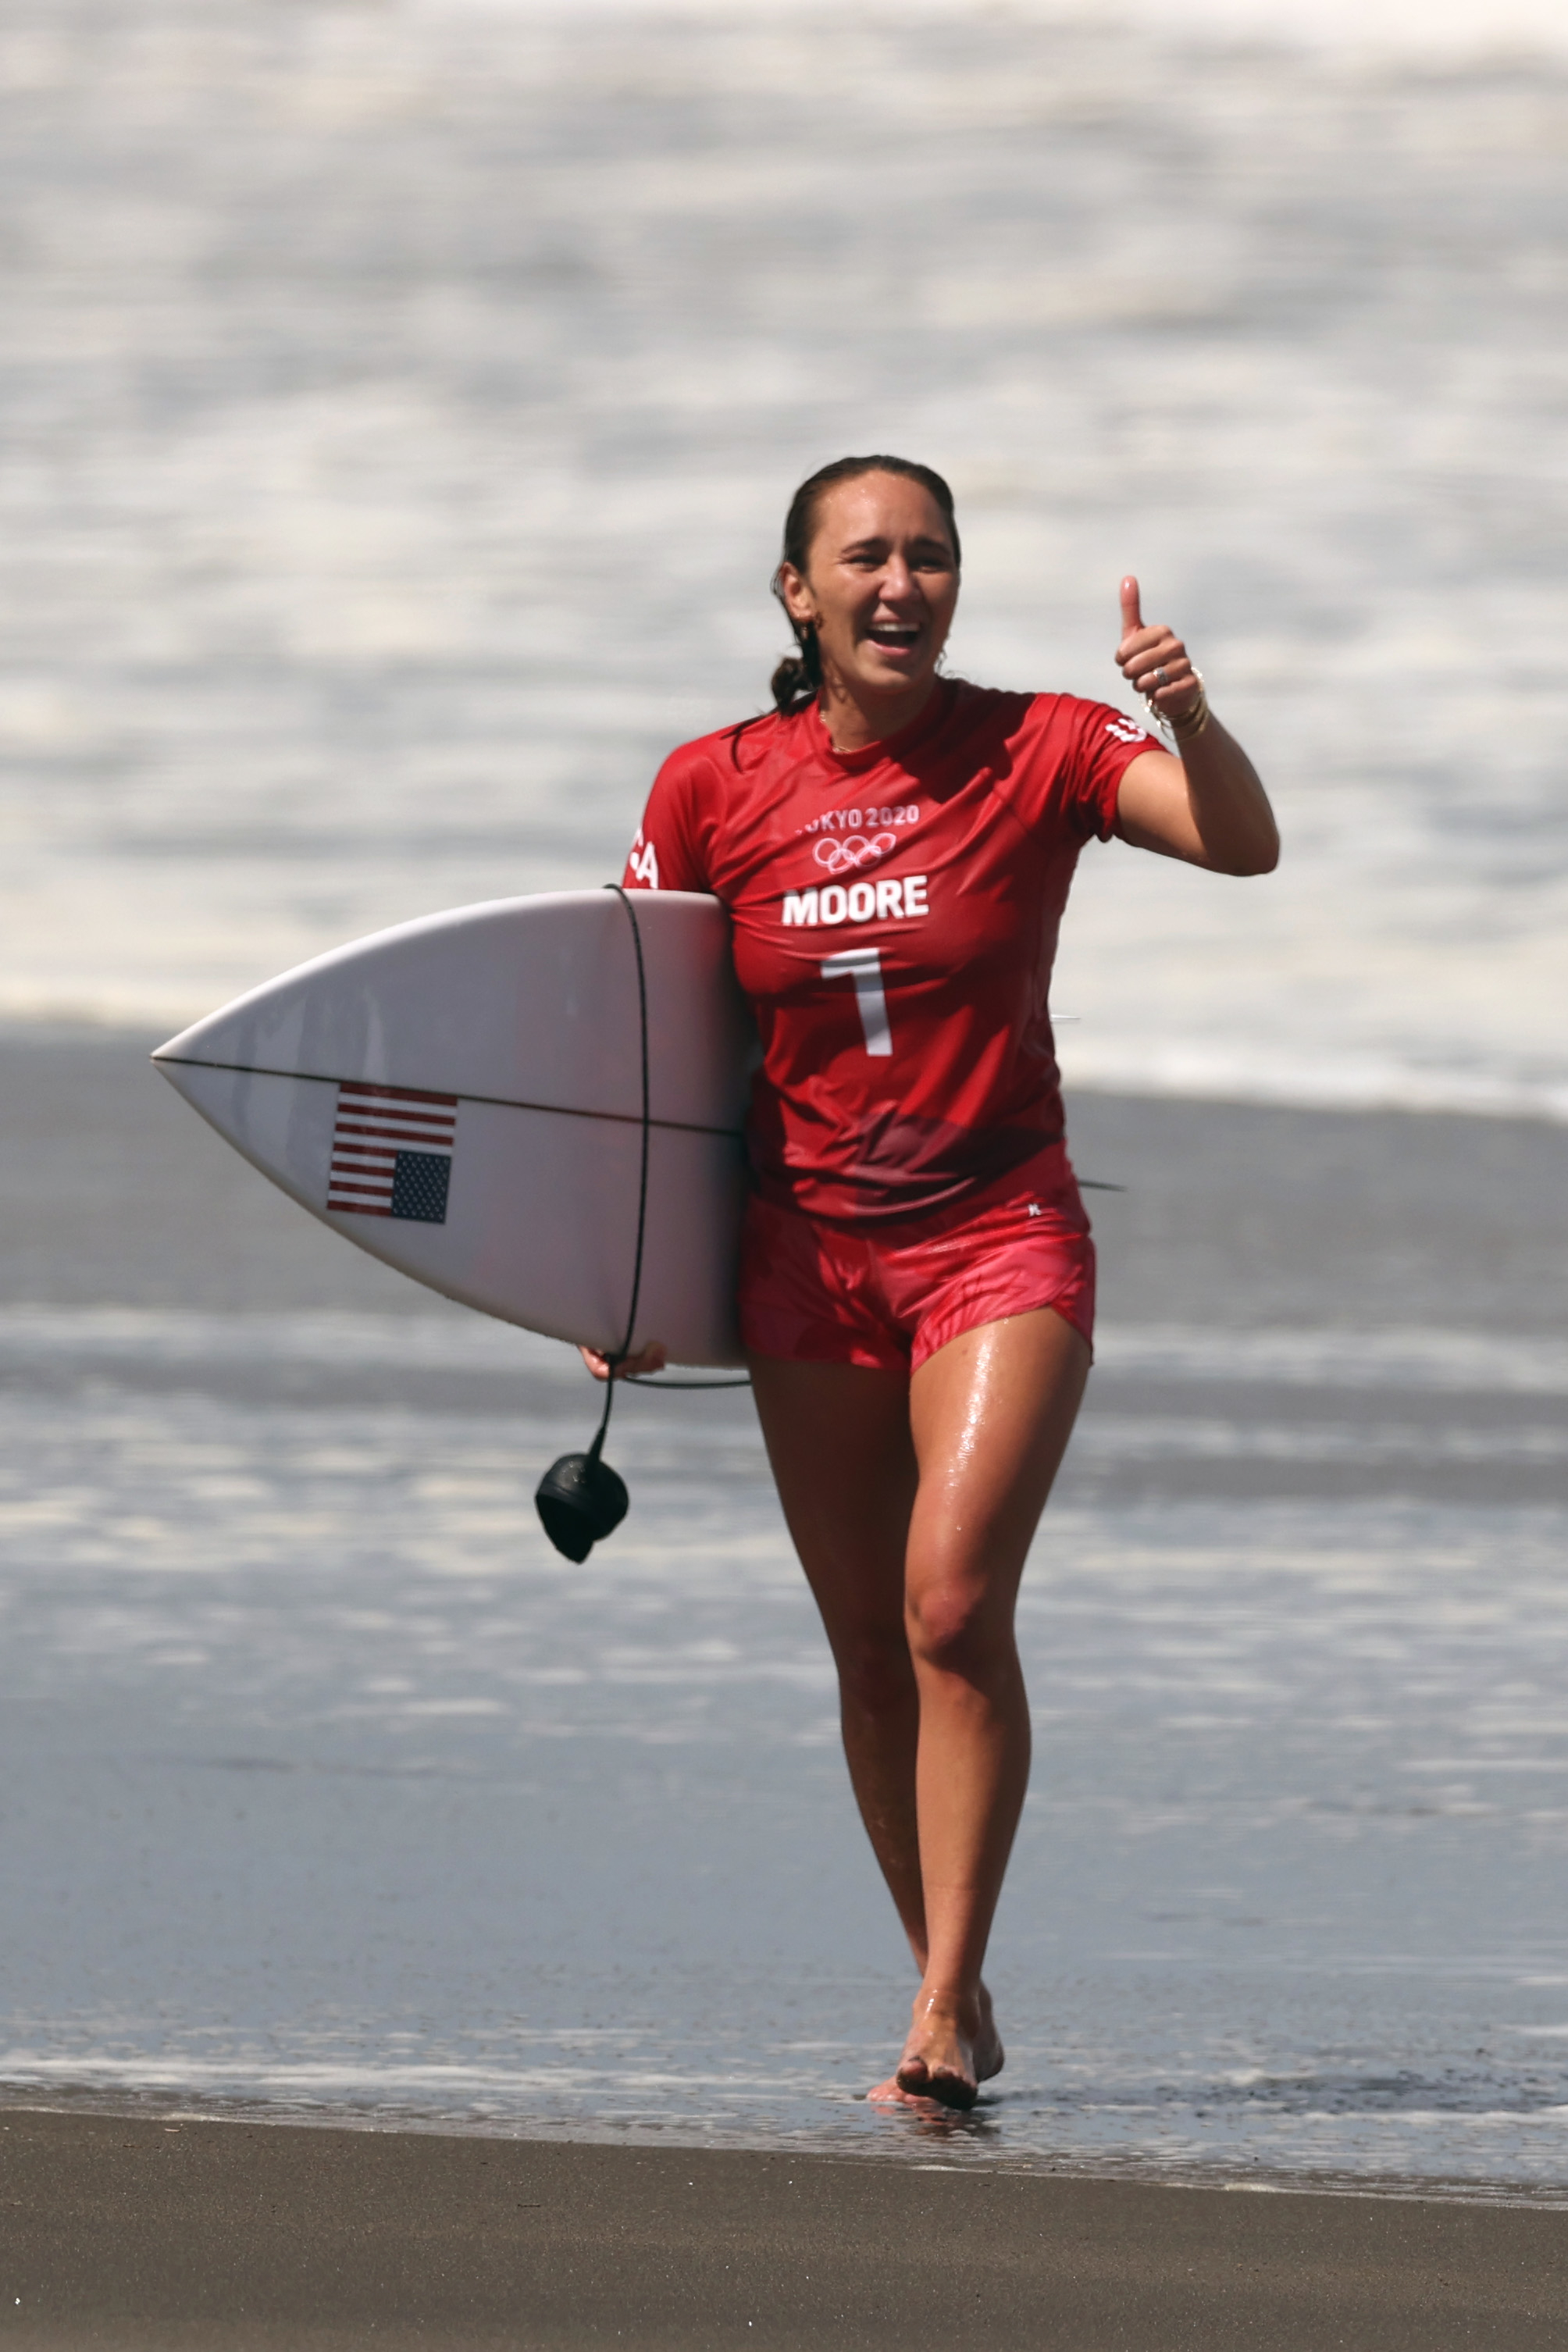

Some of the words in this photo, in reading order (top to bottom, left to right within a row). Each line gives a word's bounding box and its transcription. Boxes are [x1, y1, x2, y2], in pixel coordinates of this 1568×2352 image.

[795, 809, 861, 834] KYO
[865, 804, 920, 828] 2020
[782, 875, 928, 925] MOORE
